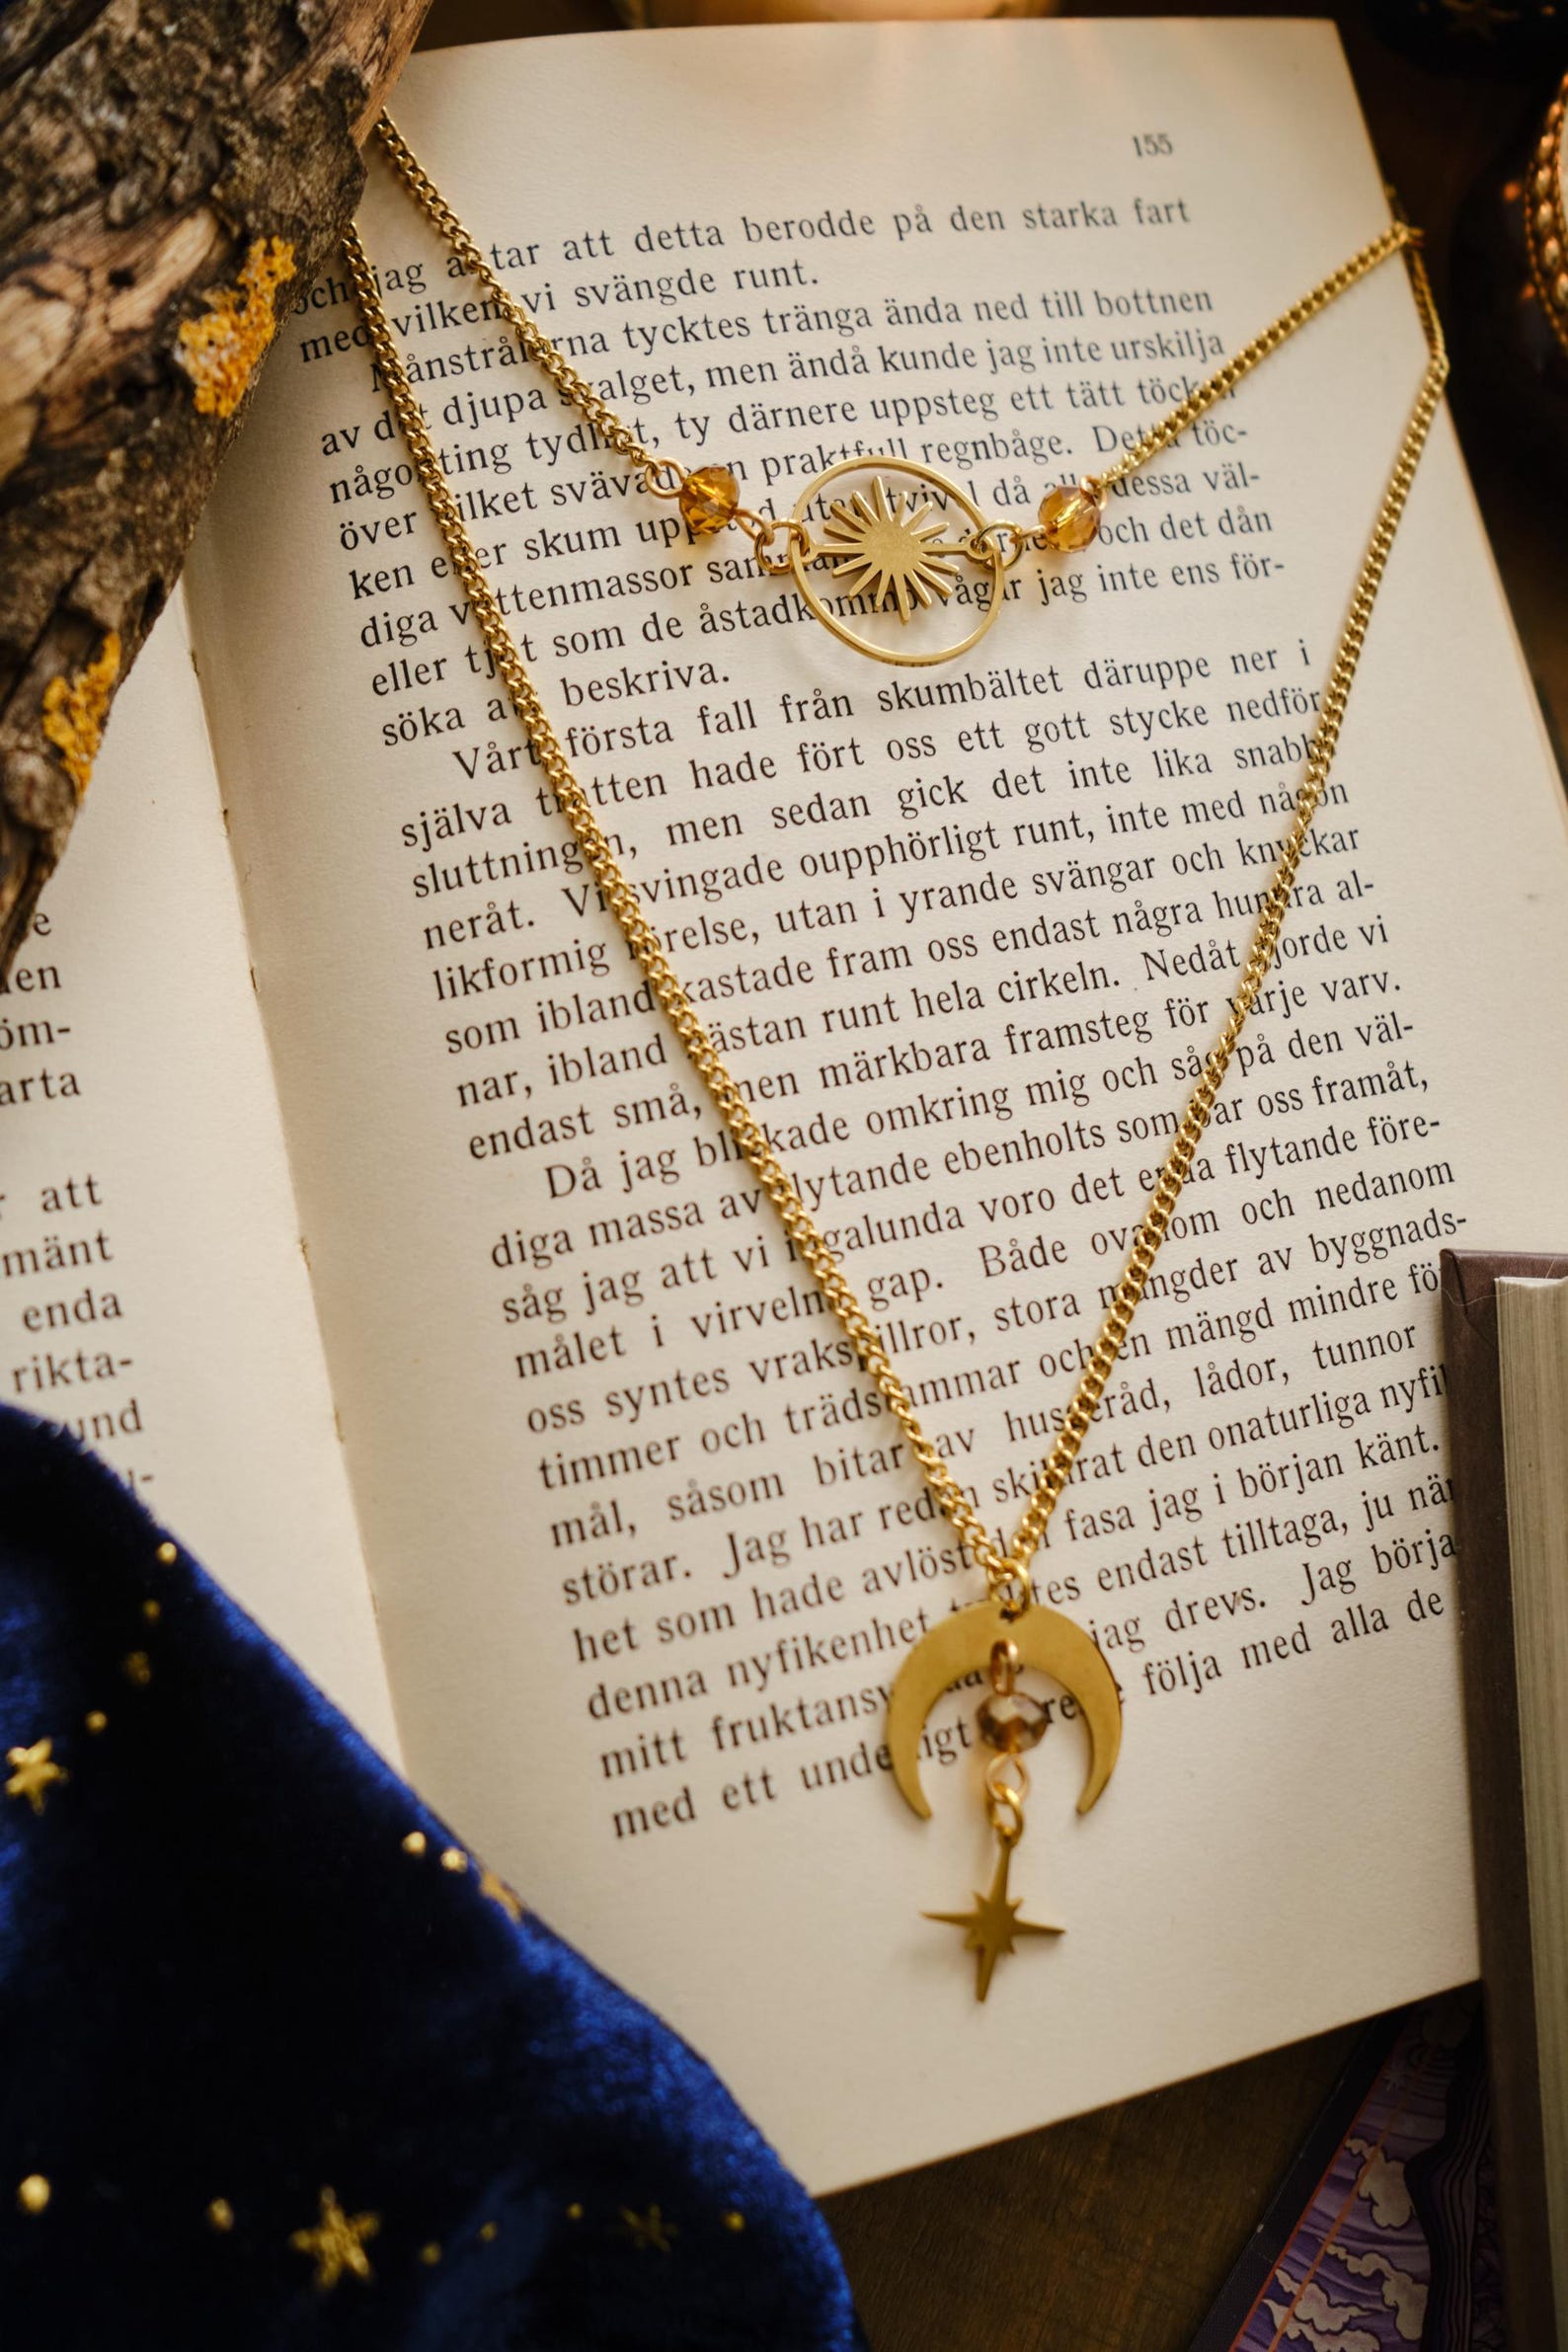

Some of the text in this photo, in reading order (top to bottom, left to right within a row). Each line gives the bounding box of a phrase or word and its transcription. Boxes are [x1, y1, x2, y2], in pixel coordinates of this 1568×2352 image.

[1131, 131, 1175, 159] 155
[519, 258, 819, 315] vi svängde runt.
[562, 196, 1190, 262] att detta berodde på den starka fart
[320, 328, 1225, 457] av djupa men ändå kunde jag inte urskilja
[621, 289, 1214, 357] tycktes tränga ända ned till bottnen
[339, 418, 1250, 552] över regnbåge. töc-
[673, 380, 1126, 447] ty därnere uppsteg ett tätt
[348, 460, 1261, 601] ken skum då väl-
[359, 505, 1274, 649] diga det dån
[370, 551, 1286, 698] eller som de inte för-
[381, 659, 731, 747] söka beskriva.
[400, 699, 1210, 854] själva hade fört ett gott stycke
[563, 648, 1279, 758] första fall från skumbältet däruppe ner
[423, 788, 1247, 951] neråt. oupphörligt runt, inte med
[665, 746, 1214, 847] men sedan gick inte lika
[431, 856, 1156, 1002] likformig utan yrande svängar
[444, 868, 1375, 1056] som fram endast några al-
[455, 938, 1242, 1109] nar, ibland runt hela cirkeln. Nedåt
[468, 971, 1401, 1161] endast små, märkbara framsteg för varv.
[490, 1058, 1429, 1271] diga massa ebenholts framåt,
[543, 1009, 1414, 1201] Då omkring mig den väl-
[40, 1174, 103, 1214] att
[502, 1114, 1441, 1325] såg att voro det flytande före-
[22, 1288, 123, 1333] enda
[513, 1160, 1456, 1380] målet gap. Både och nedanom
[526, 1207, 1467, 1435] oss syntes stora byggnads-
[12, 1351, 133, 1394] rikta-
[537, 1275, 1399, 1491] timmer mängd mindre
[549, 1324, 1417, 1549] mål, såsom lådor, tunnor
[561, 1389, 1372, 1607] störar. Jag har den onaturliga
[572, 1423, 1441, 1665] het som hade fasa början känt.
[587, 1670, 709, 1721] denna
[726, 1607, 928, 1693] nyfikenhet
[1096, 1534, 1210, 1593] endast
[1219, 1509, 1349, 1560] tilltaga,
[1360, 1489, 1395, 1533] ju
[599, 1558, 1358, 1780] mitt drevs. Jag
[611, 1587, 1446, 1841] med ett följa med alla de
